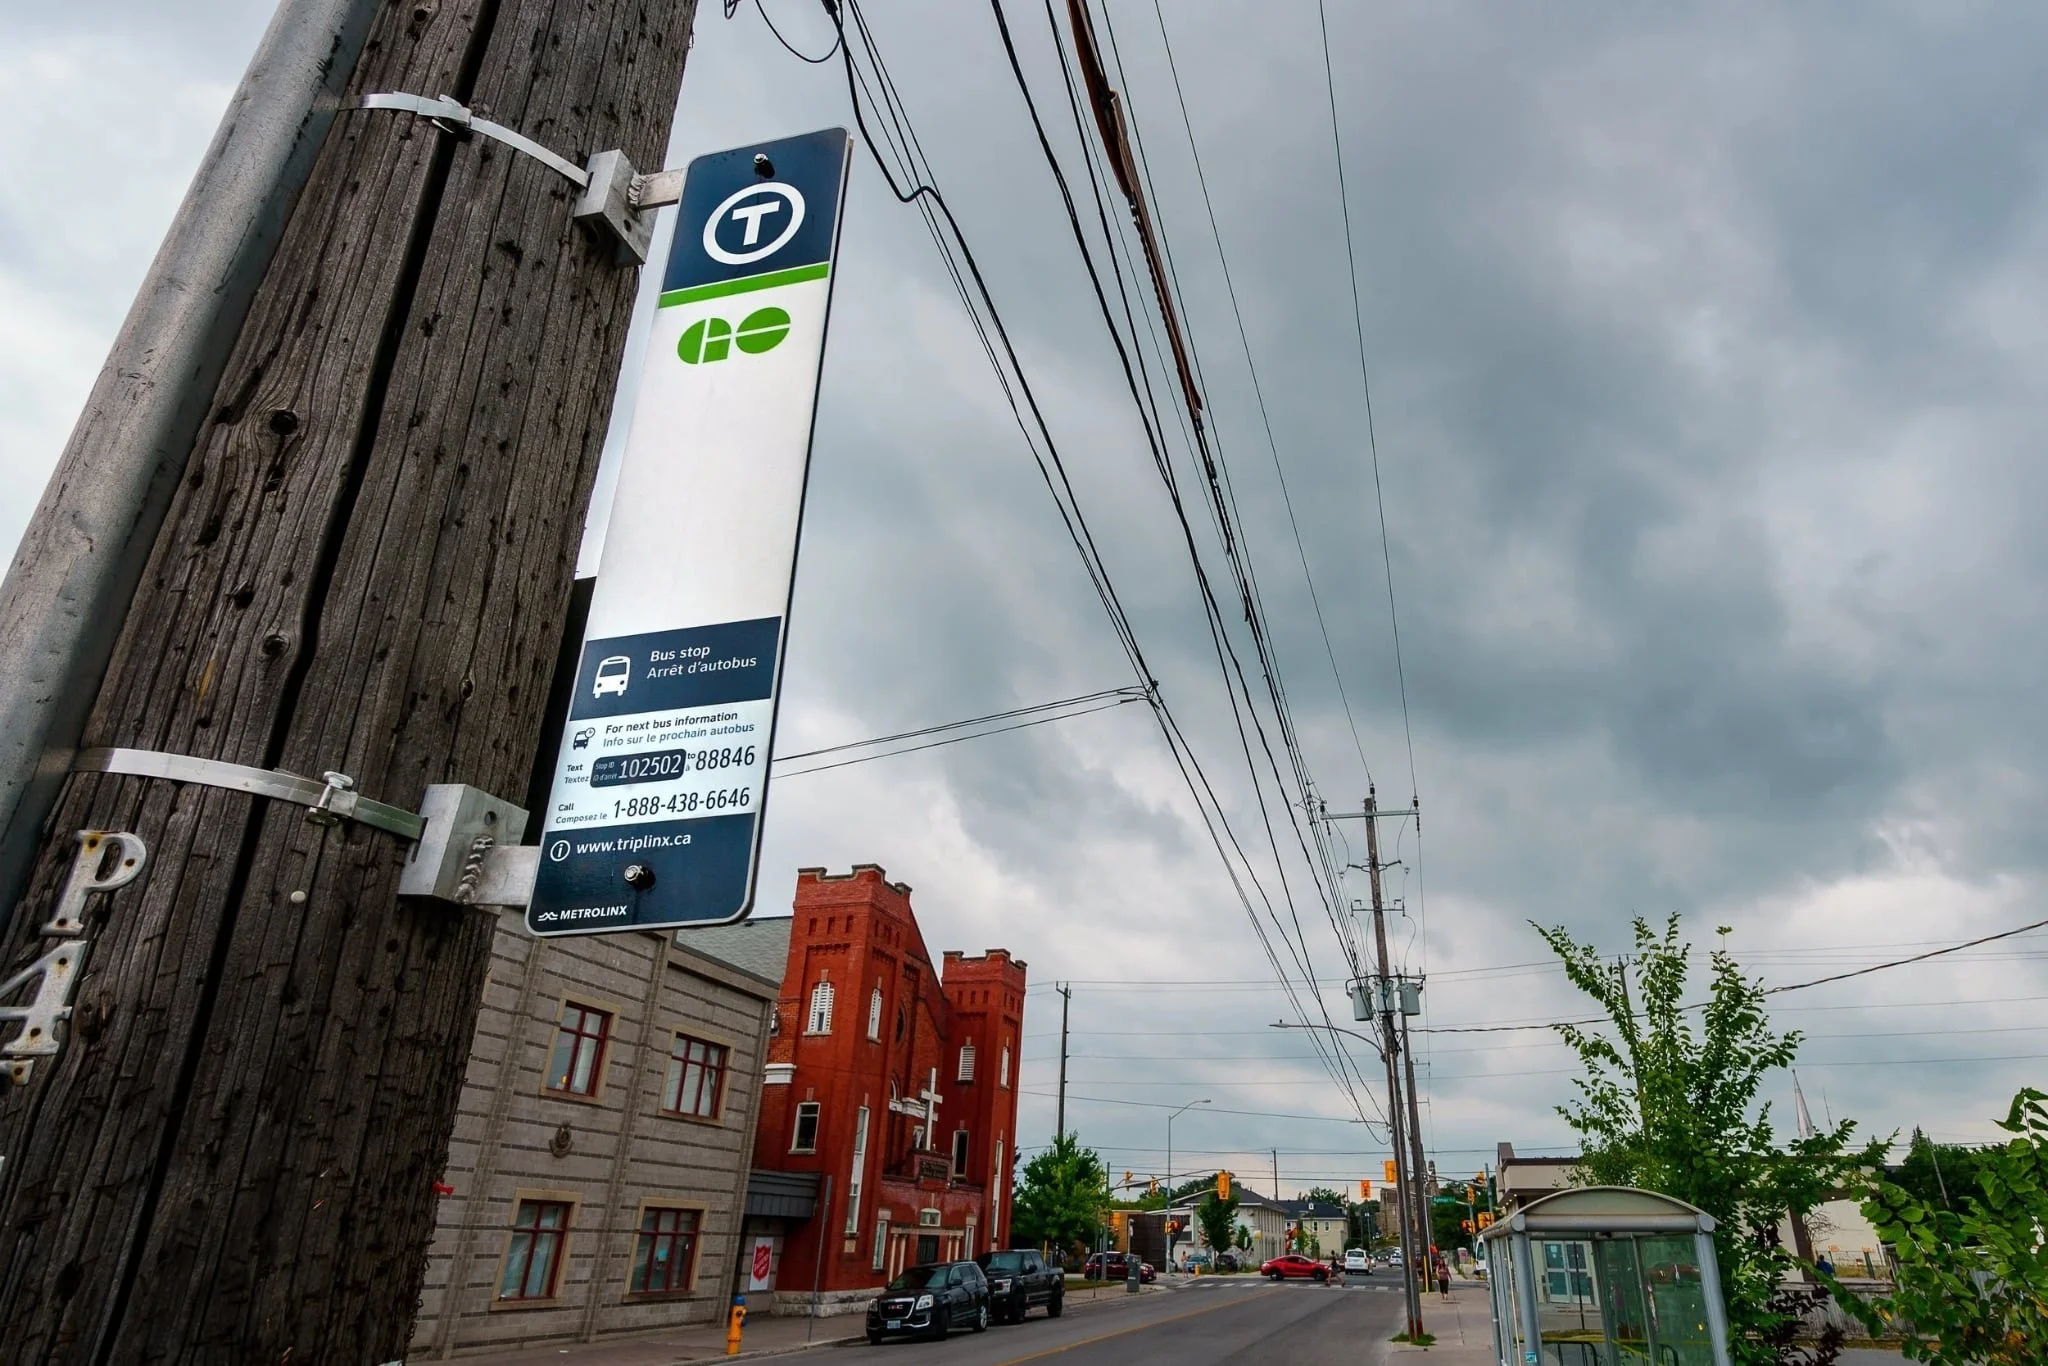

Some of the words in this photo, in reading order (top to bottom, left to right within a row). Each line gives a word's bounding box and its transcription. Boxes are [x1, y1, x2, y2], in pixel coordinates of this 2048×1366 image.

[732, 200, 781, 246] T
[677, 307, 791, 365] GO
[650, 650, 676, 662] Bus
[679, 646, 711, 659] stop
[646, 664, 683, 679] Arrêt
[605, 724, 624, 735] For
[625, 721, 649, 732] next
[653, 719, 671, 729] bus
[674, 711, 738, 727] information
[603, 737, 624, 747] Info
[626, 736, 643, 745] sur
[647, 733, 656, 743] le
[659, 728, 707, 743] prochain
[710, 723, 755, 736] autobus
[687, 752, 696, 760] to
[695, 745, 755, 771] 88846
[567, 764, 583, 772] Text
[618, 754, 682, 779] 102502
[564, 775, 589, 784] Textez
[558, 803, 574, 812] Call
[614, 786, 750, 819] 1-888-438-6646
[555, 814, 597, 824] Composez
[599, 812, 607, 820] le
[576, 834, 692, 854] www.triplinx.ca
[559, 905, 628, 920] METROLINX
